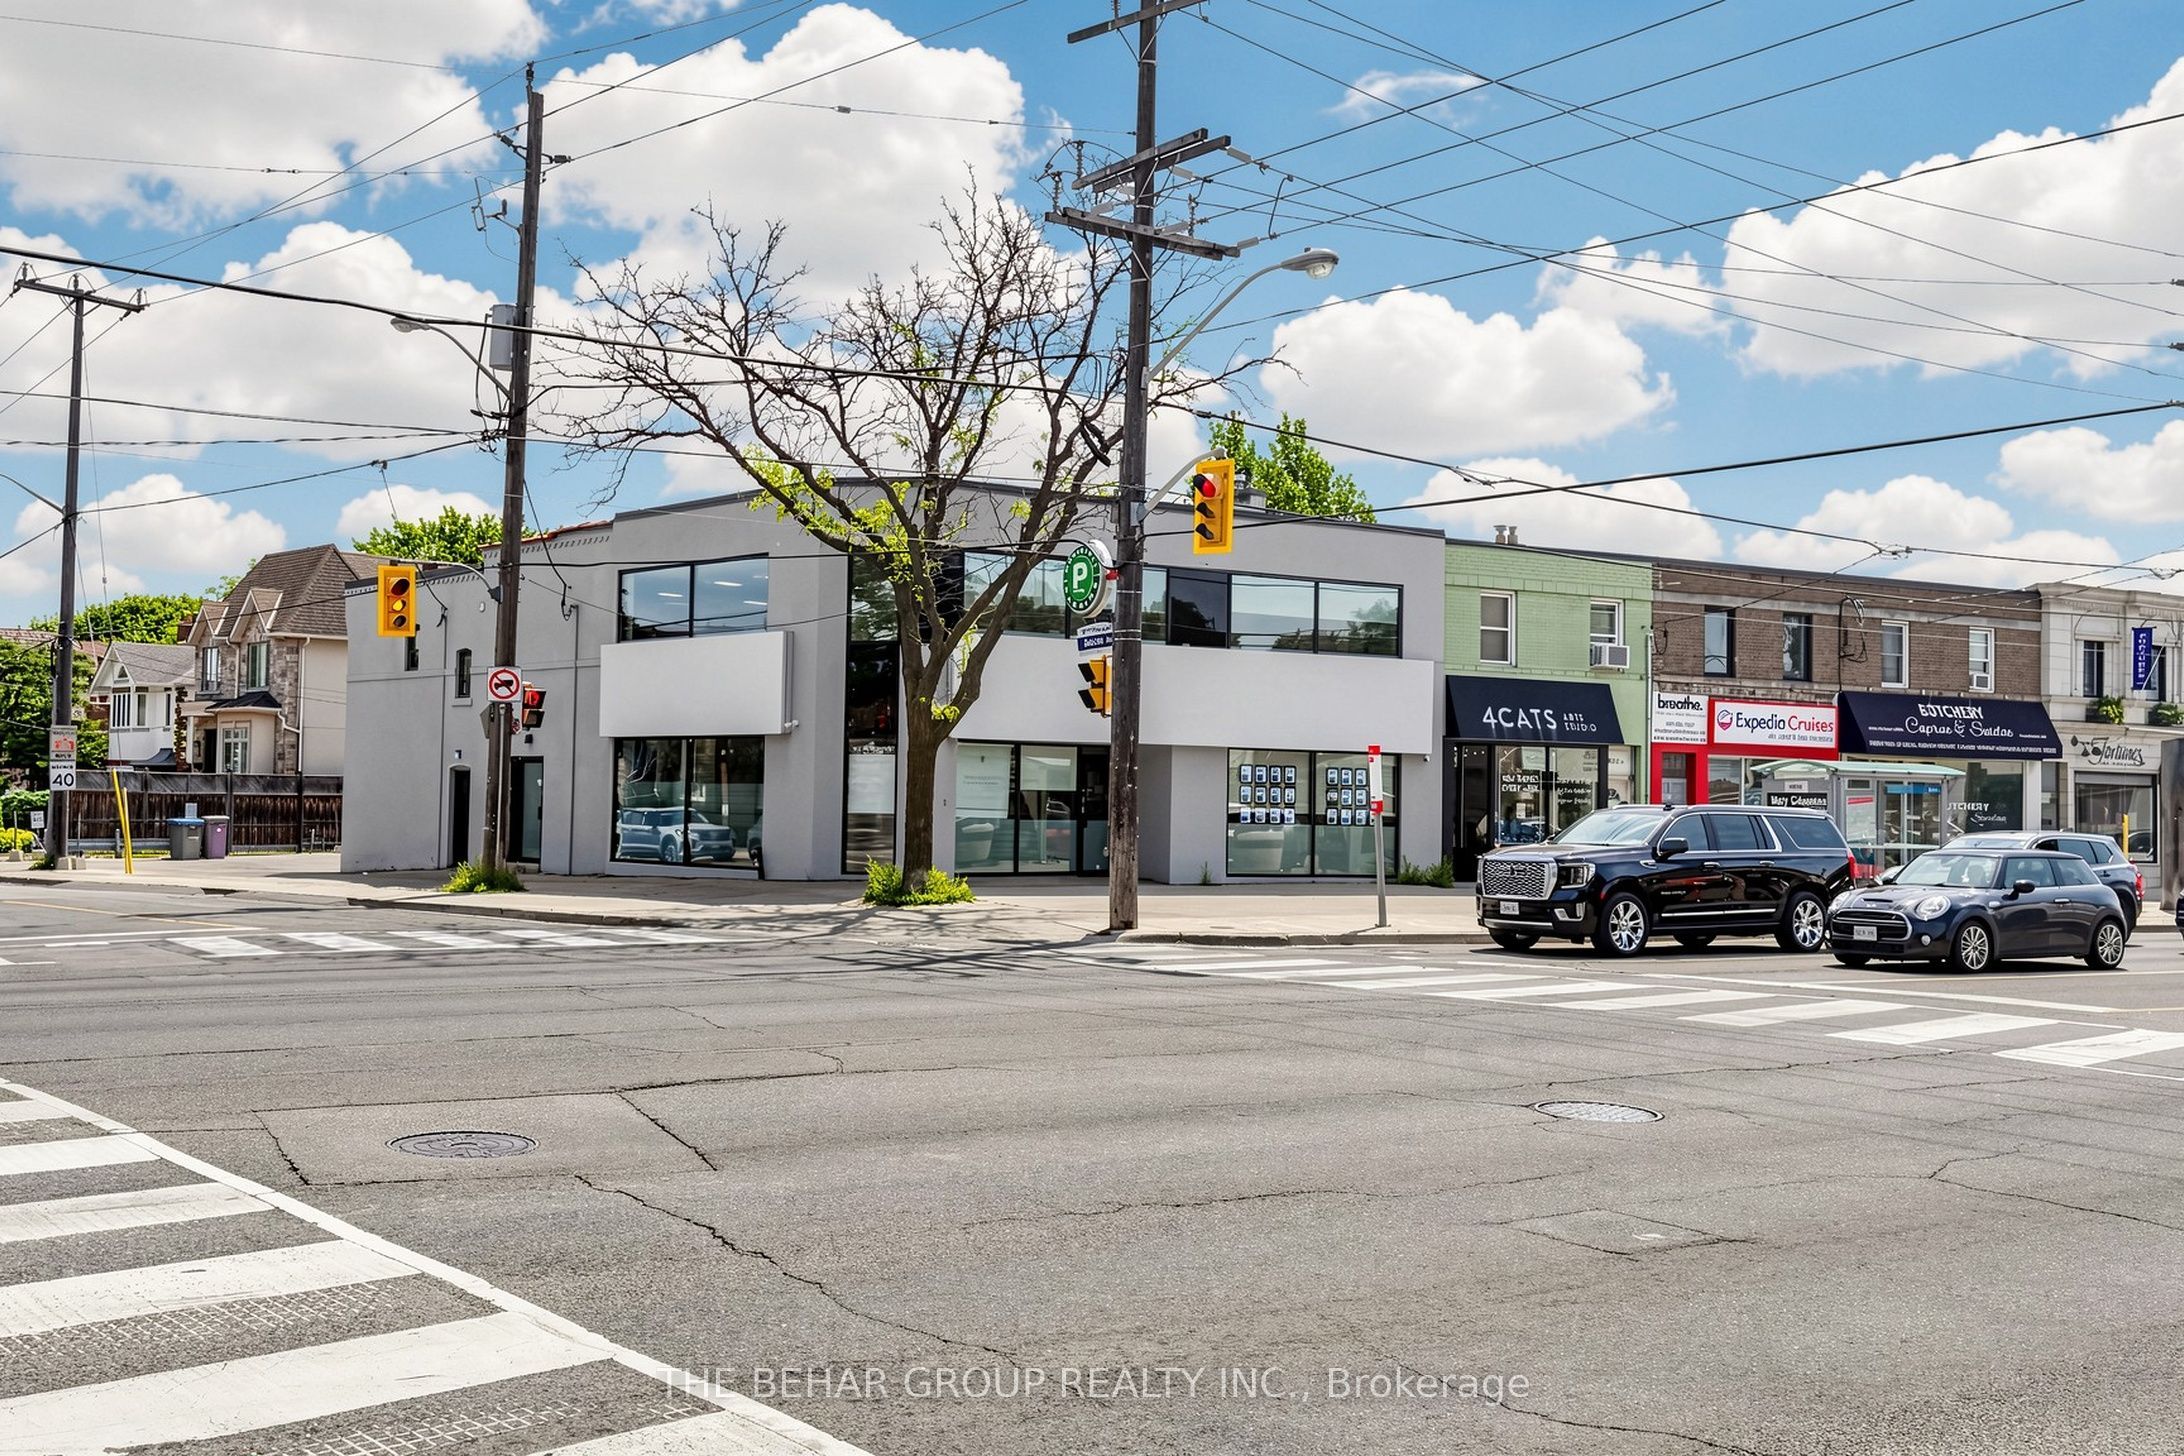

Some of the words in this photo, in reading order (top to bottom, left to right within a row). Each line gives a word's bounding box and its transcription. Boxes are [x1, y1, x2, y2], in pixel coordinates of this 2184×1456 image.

[1482, 706, 1557, 729] 4CATS
[1735, 711, 1786, 733] Expedia
[1787, 715, 1839, 732] Cruises
[52, 773, 75, 787] 40
